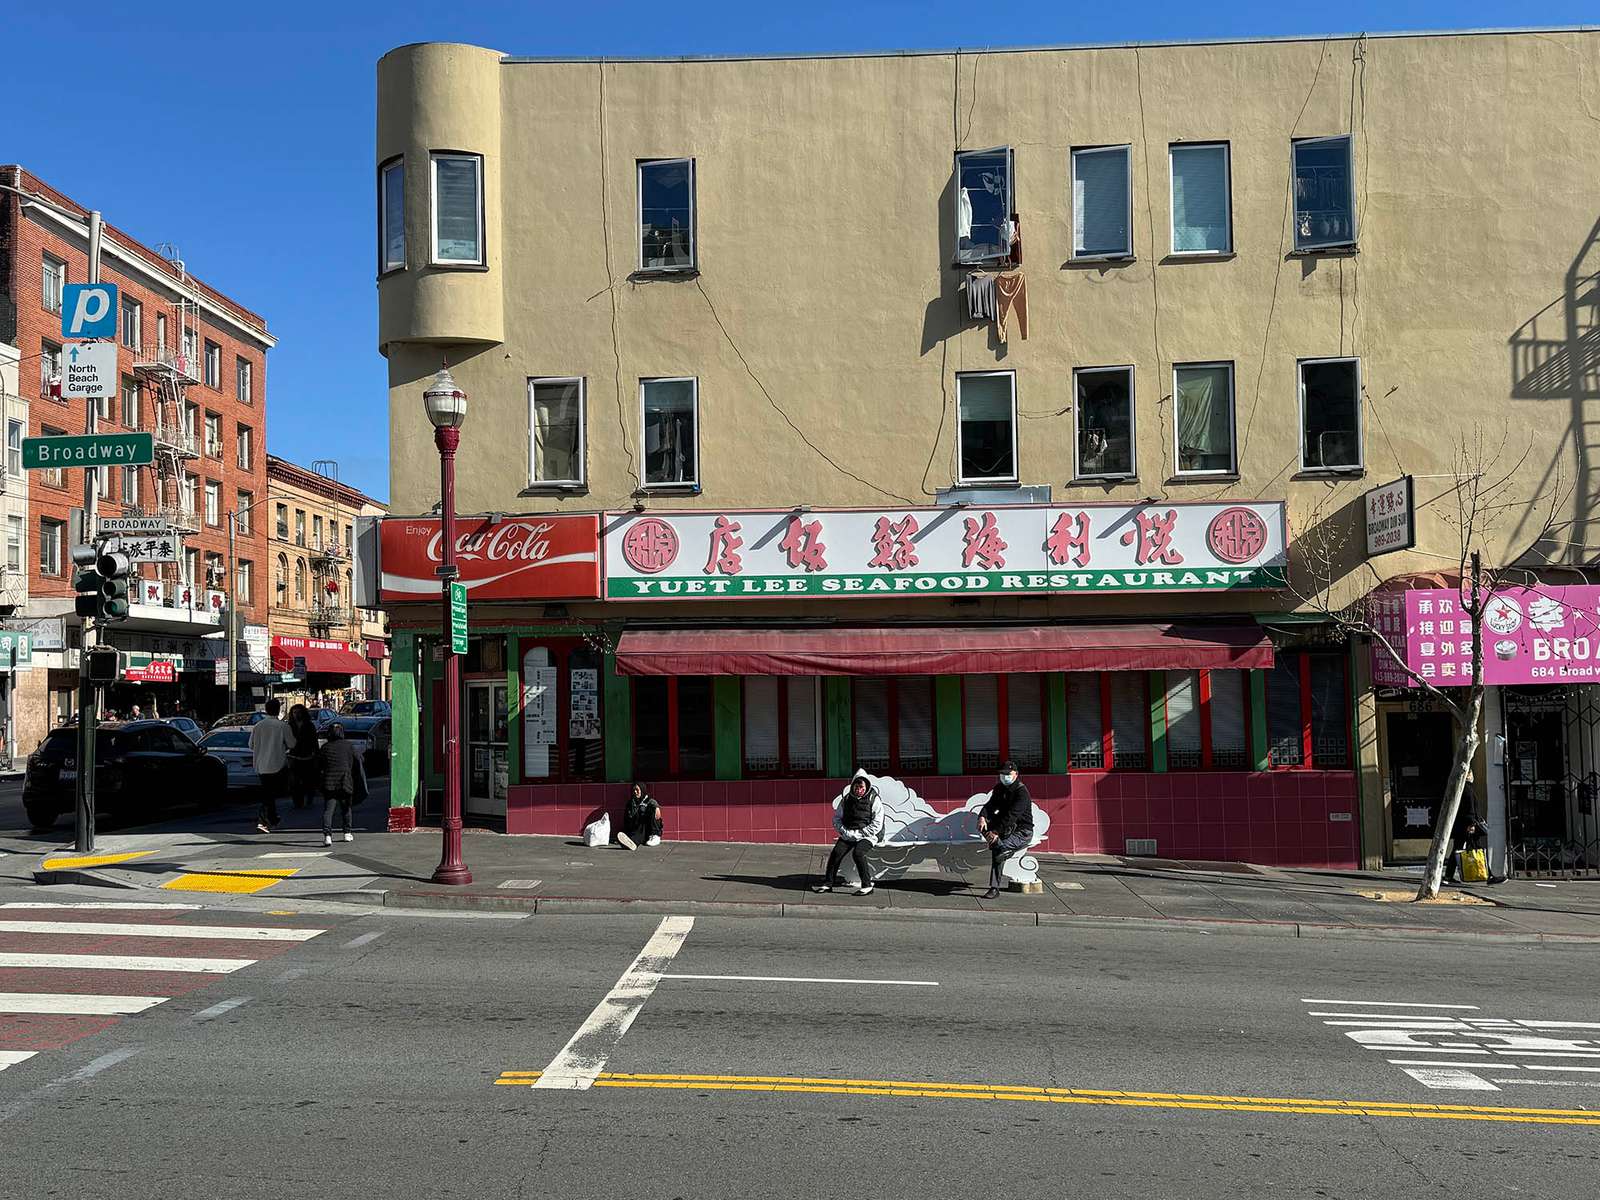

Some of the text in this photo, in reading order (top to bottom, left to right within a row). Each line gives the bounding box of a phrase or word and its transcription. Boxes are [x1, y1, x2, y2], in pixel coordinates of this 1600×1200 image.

[68, 364, 97, 374] North
[68, 373, 99, 383] Beach
[68, 383, 103, 394] Garage
[38, 442, 137, 461] Broadway
[103, 519, 161, 529] BROADWAY
[406, 525, 432, 537] Enjoy
[427, 522, 557, 562] Cca-Cola
[632, 570, 1258, 594] YUET LEE SEAFOOD RESTAURANT
[1531, 667, 1555, 677] 684
[1409, 701, 1433, 713] 686
